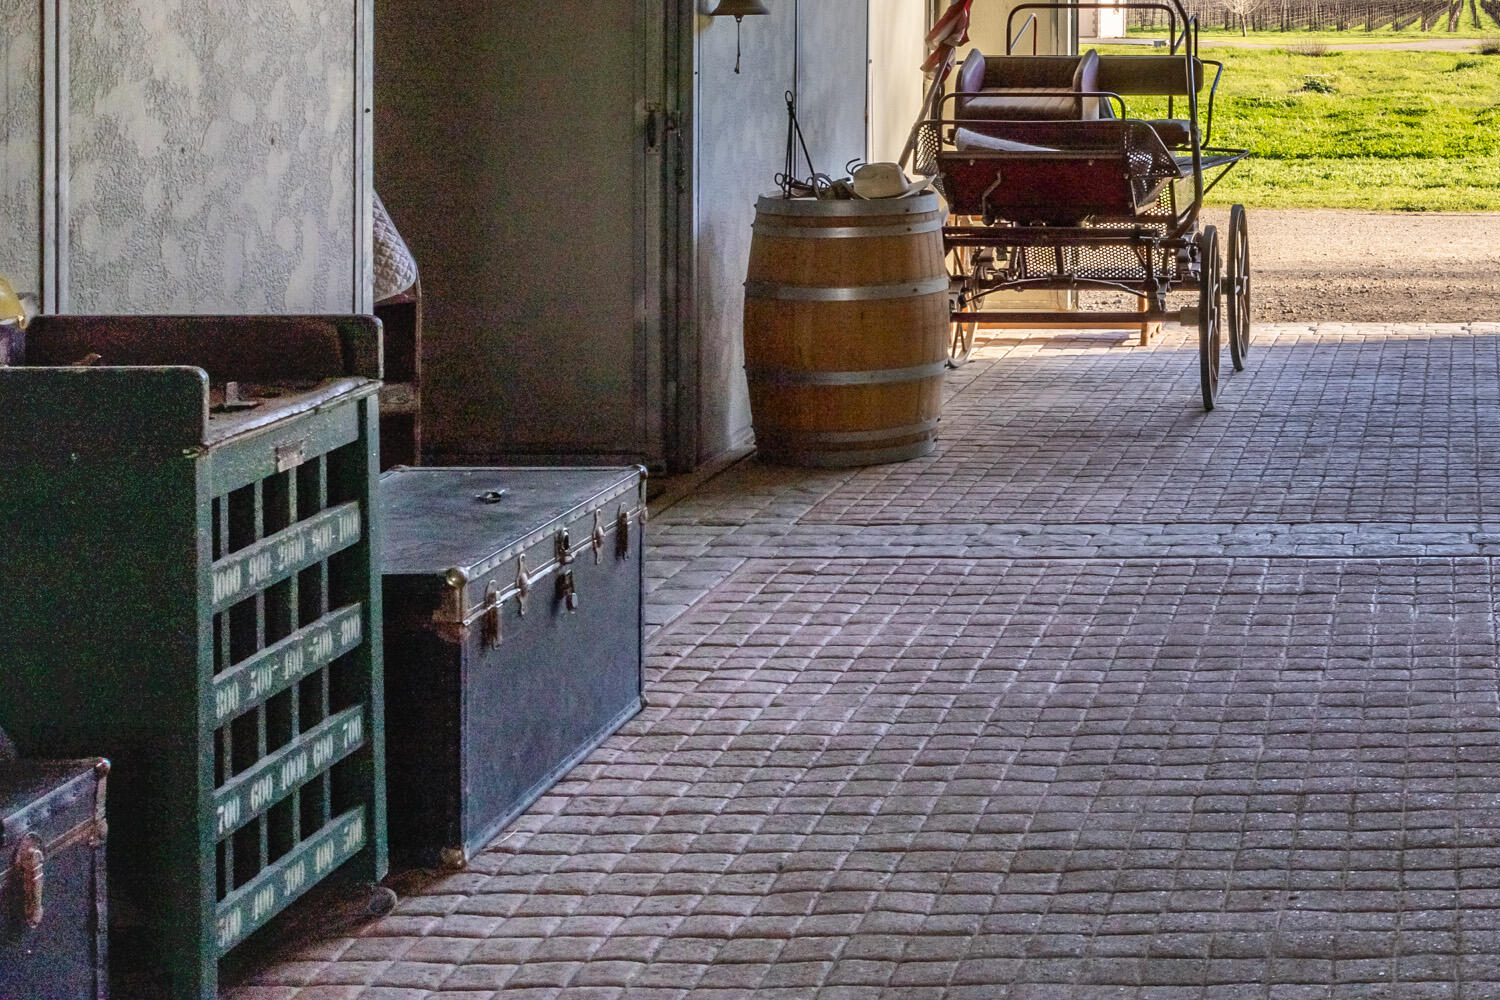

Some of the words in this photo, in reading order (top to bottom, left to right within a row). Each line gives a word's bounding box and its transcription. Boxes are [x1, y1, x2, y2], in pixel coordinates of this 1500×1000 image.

[213, 564, 241, 603] 1000
[216, 682, 239, 719] 800
[250, 666, 272, 699] 500
[341, 614, 361, 645] 800
[216, 796, 240, 834] 700
[251, 774, 273, 811] 600
[281, 751, 307, 790] 1000
[313, 734, 333, 768] 600
[343, 715, 361, 748] 700
[217, 907, 242, 947] 500
[344, 817, 362, 852] 500
